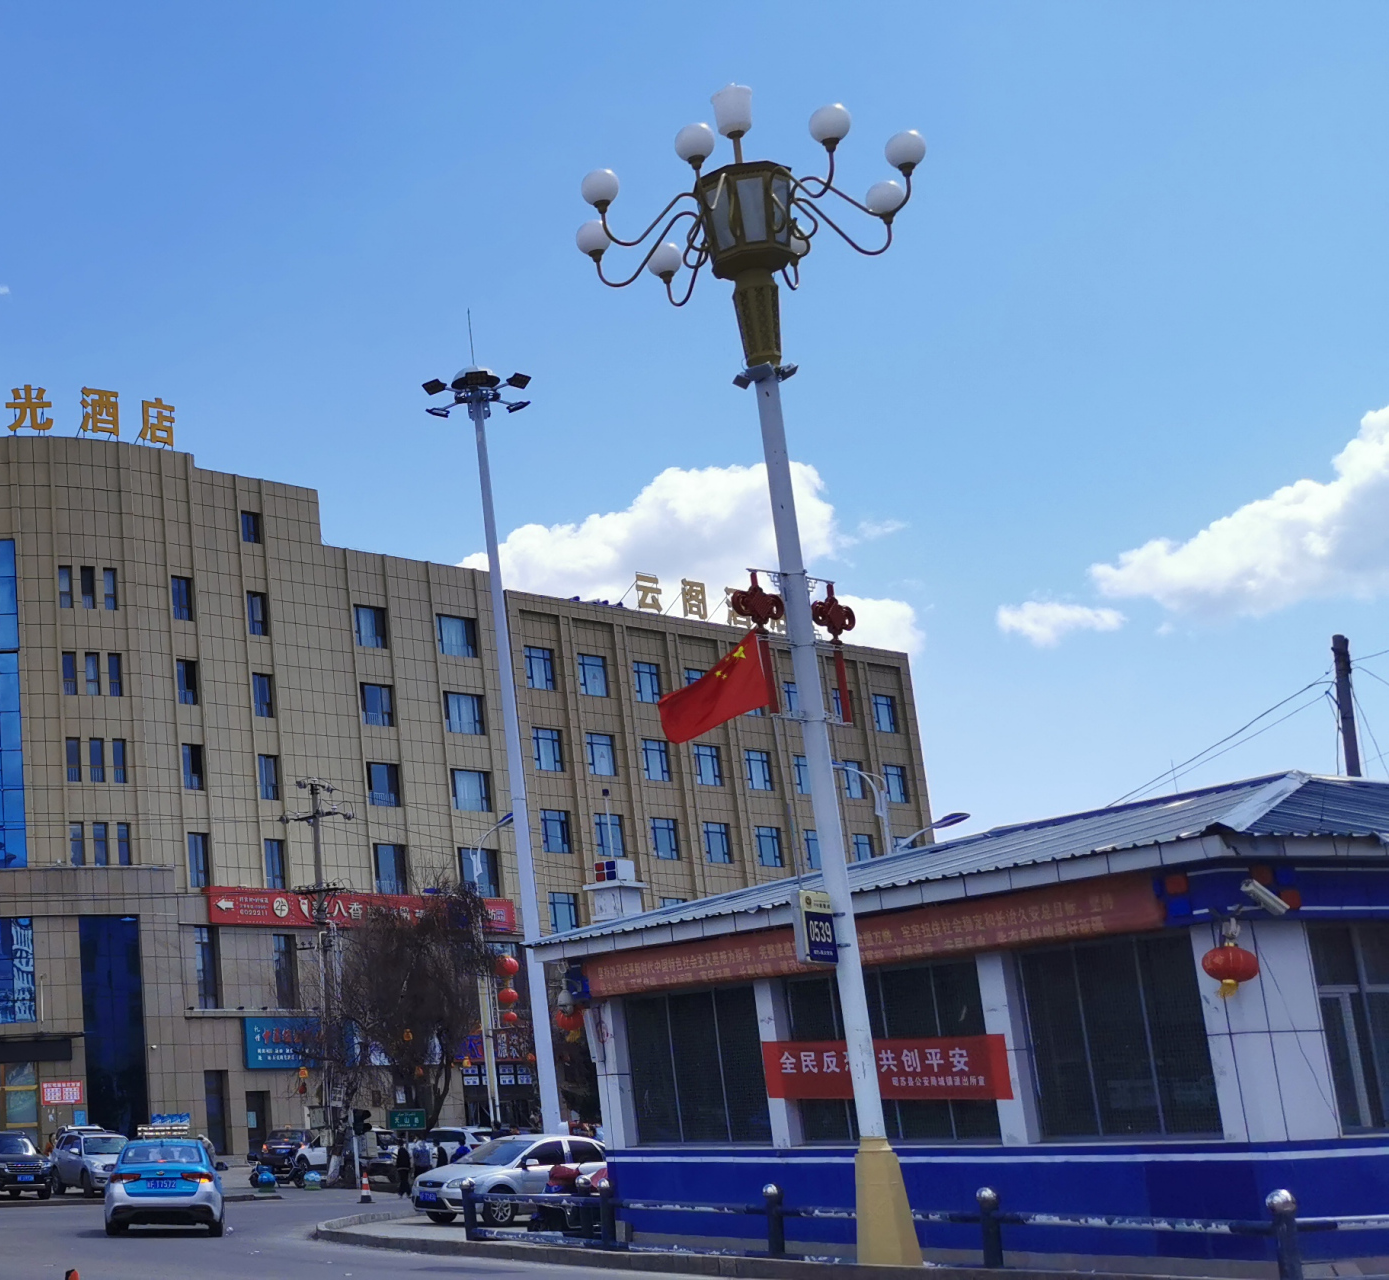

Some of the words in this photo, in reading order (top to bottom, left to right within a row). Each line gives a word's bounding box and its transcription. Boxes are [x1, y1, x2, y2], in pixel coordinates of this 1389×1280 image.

[809, 920, 833, 943] 0539
[779, 1050, 851, 1074] 全民反
[878, 1047, 970, 1073] 共创平安
[891, 1075, 986, 1087] 昭苏县公安局城镇派出所宣
